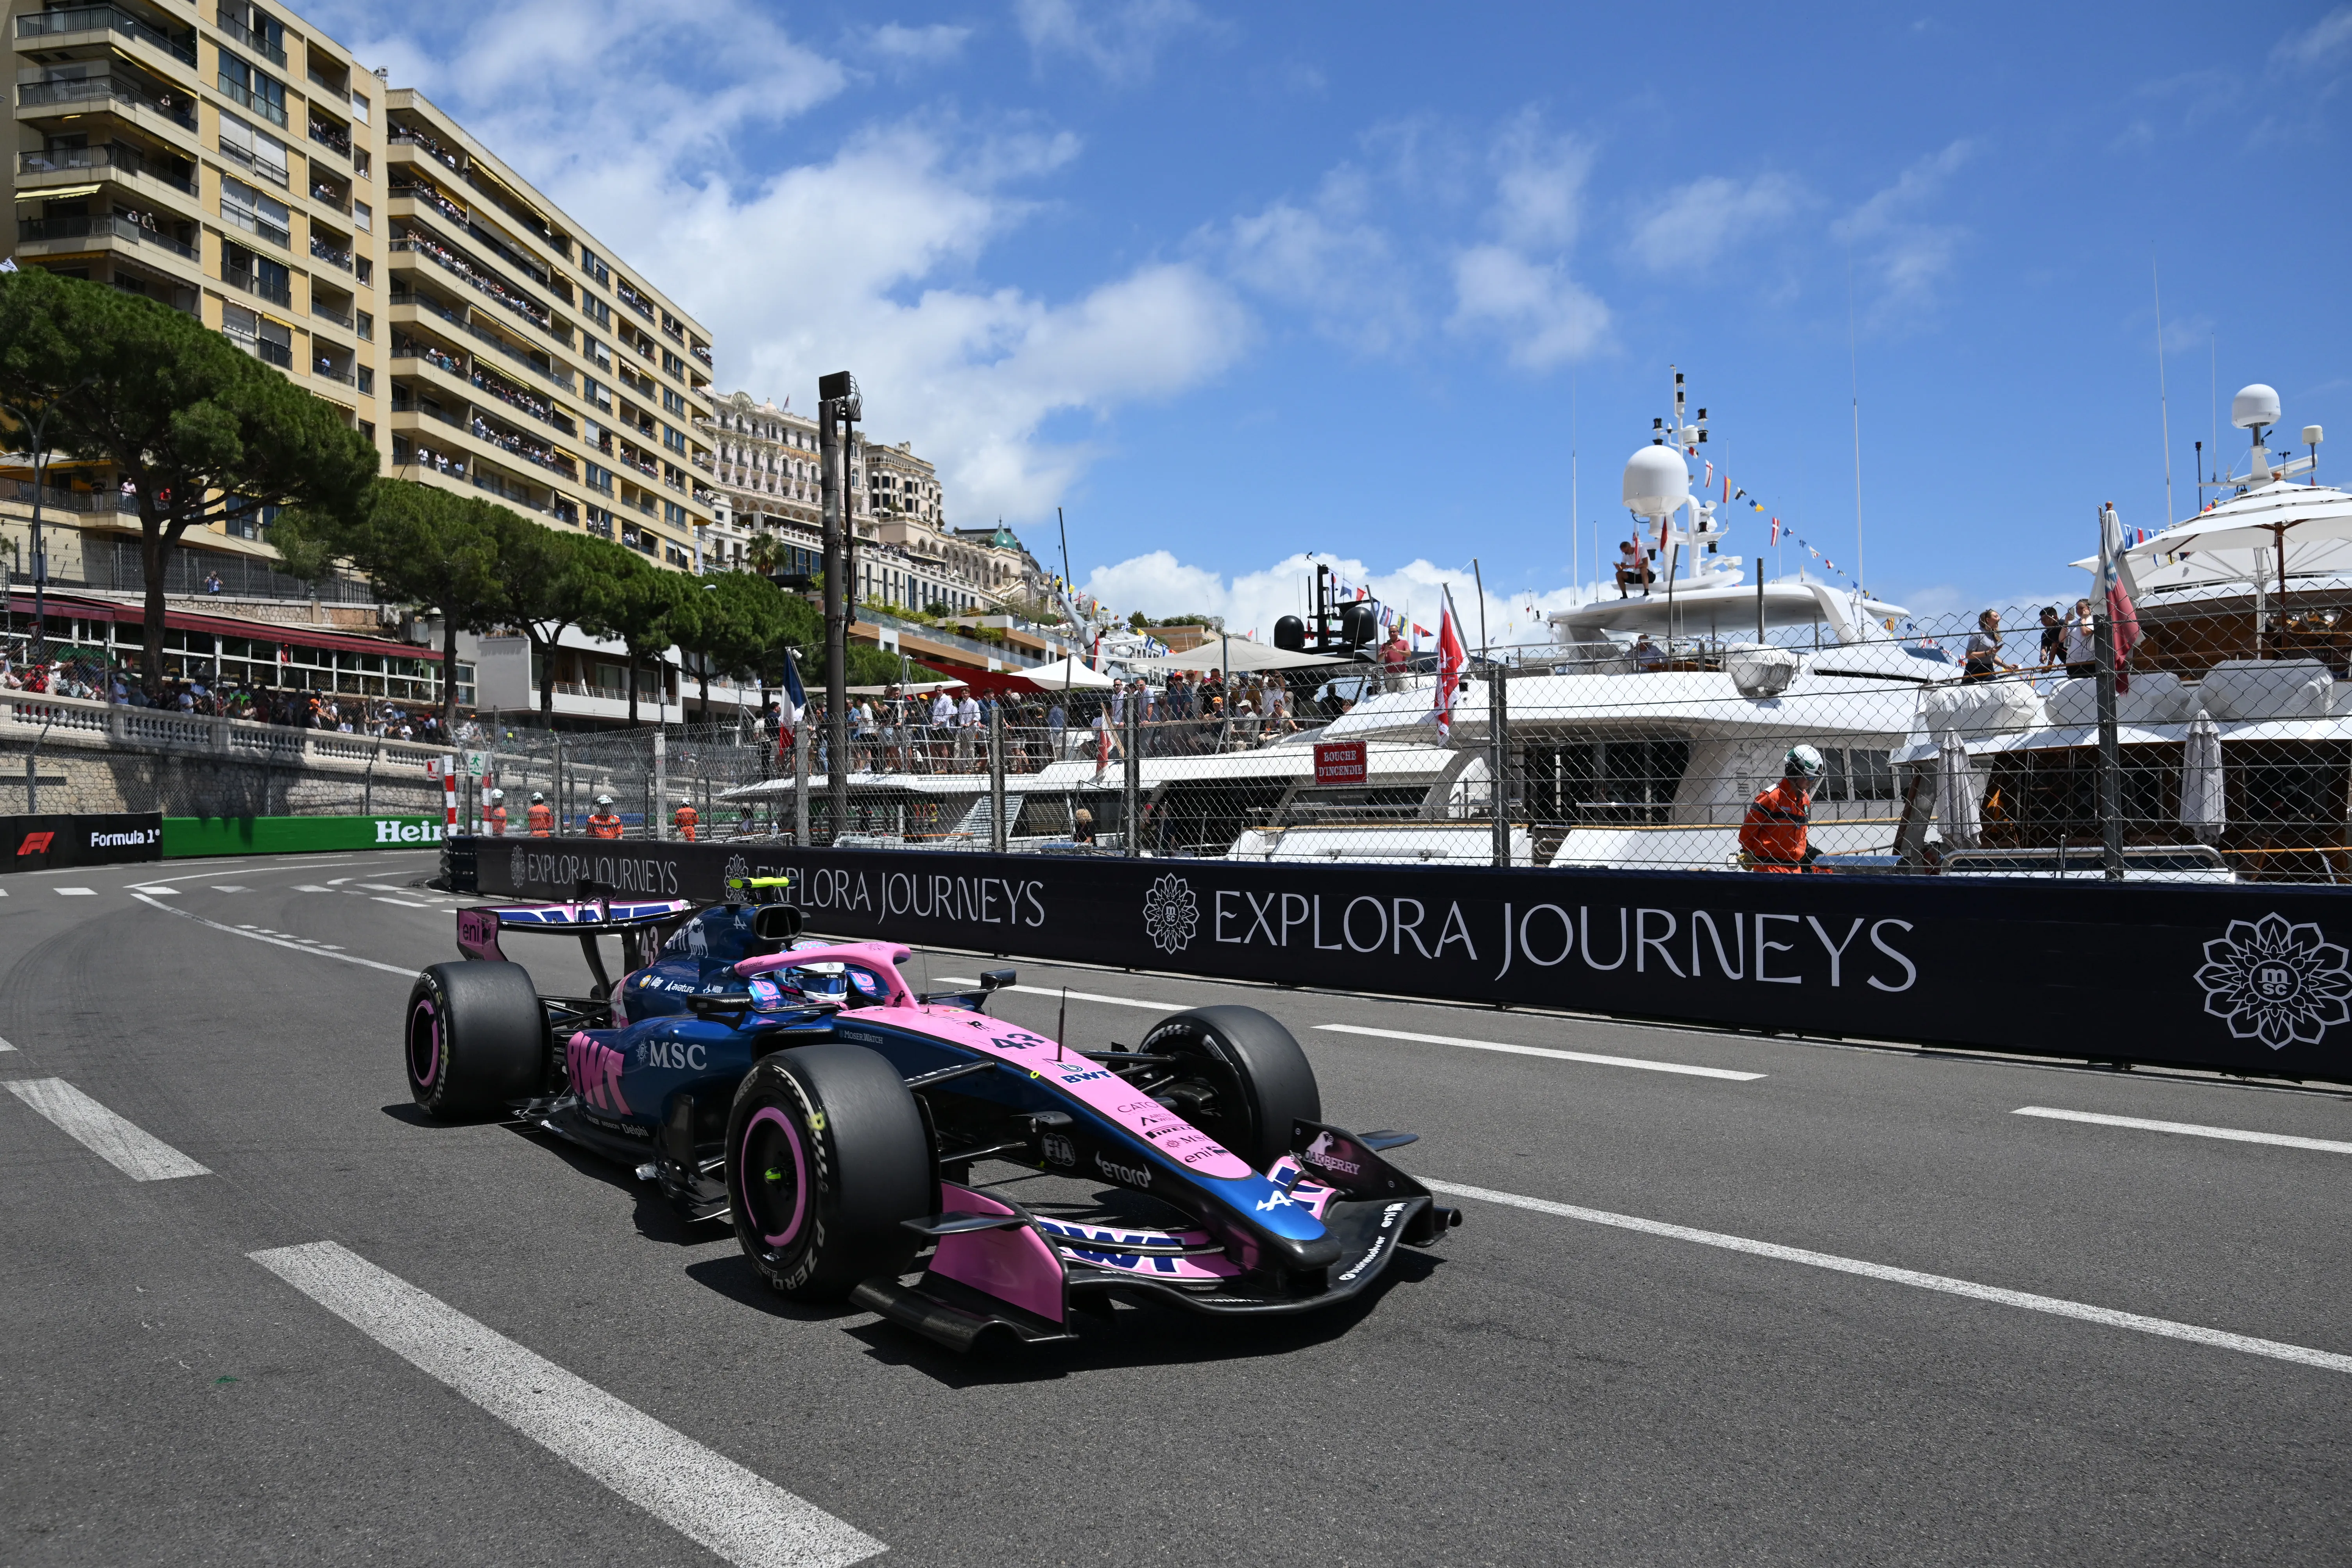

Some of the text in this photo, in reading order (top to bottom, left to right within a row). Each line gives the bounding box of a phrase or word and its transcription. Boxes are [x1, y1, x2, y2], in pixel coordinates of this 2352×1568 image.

[1324, 750, 1356, 762] BOUCHE
[1318, 764, 1363, 777] D'INCENDIE
[91, 830, 145, 847] Formula
[528, 854, 678, 895] EXPLORA JOURNEYS
[878, 872, 1044, 927] JOURNEYS
[463, 923, 480, 942] eni
[641, 926, 658, 965] 43
[1215, 891, 1917, 993] EXPLORA JOURNEYS
[671, 983, 695, 993] avature
[990, 1033, 1046, 1050] 43
[649, 1040, 707, 1070] MSC
[567, 1031, 634, 1116] BWT
[1059, 1070, 1114, 1084] BWT
[1118, 1101, 1159, 1113] CATO
[602, 1121, 620, 1130] MISSION
[621, 1123, 649, 1138] Delphi
[1145, 1124, 1198, 1139] PIRELL
[1184, 1148, 1213, 1163] eni
[1304, 1149, 1361, 1175] OAKBERRY
[1381, 1210, 1398, 1228] eni
[1351, 1235, 1386, 1274] businessolver
[772, 1247, 818, 1290] ZERO
